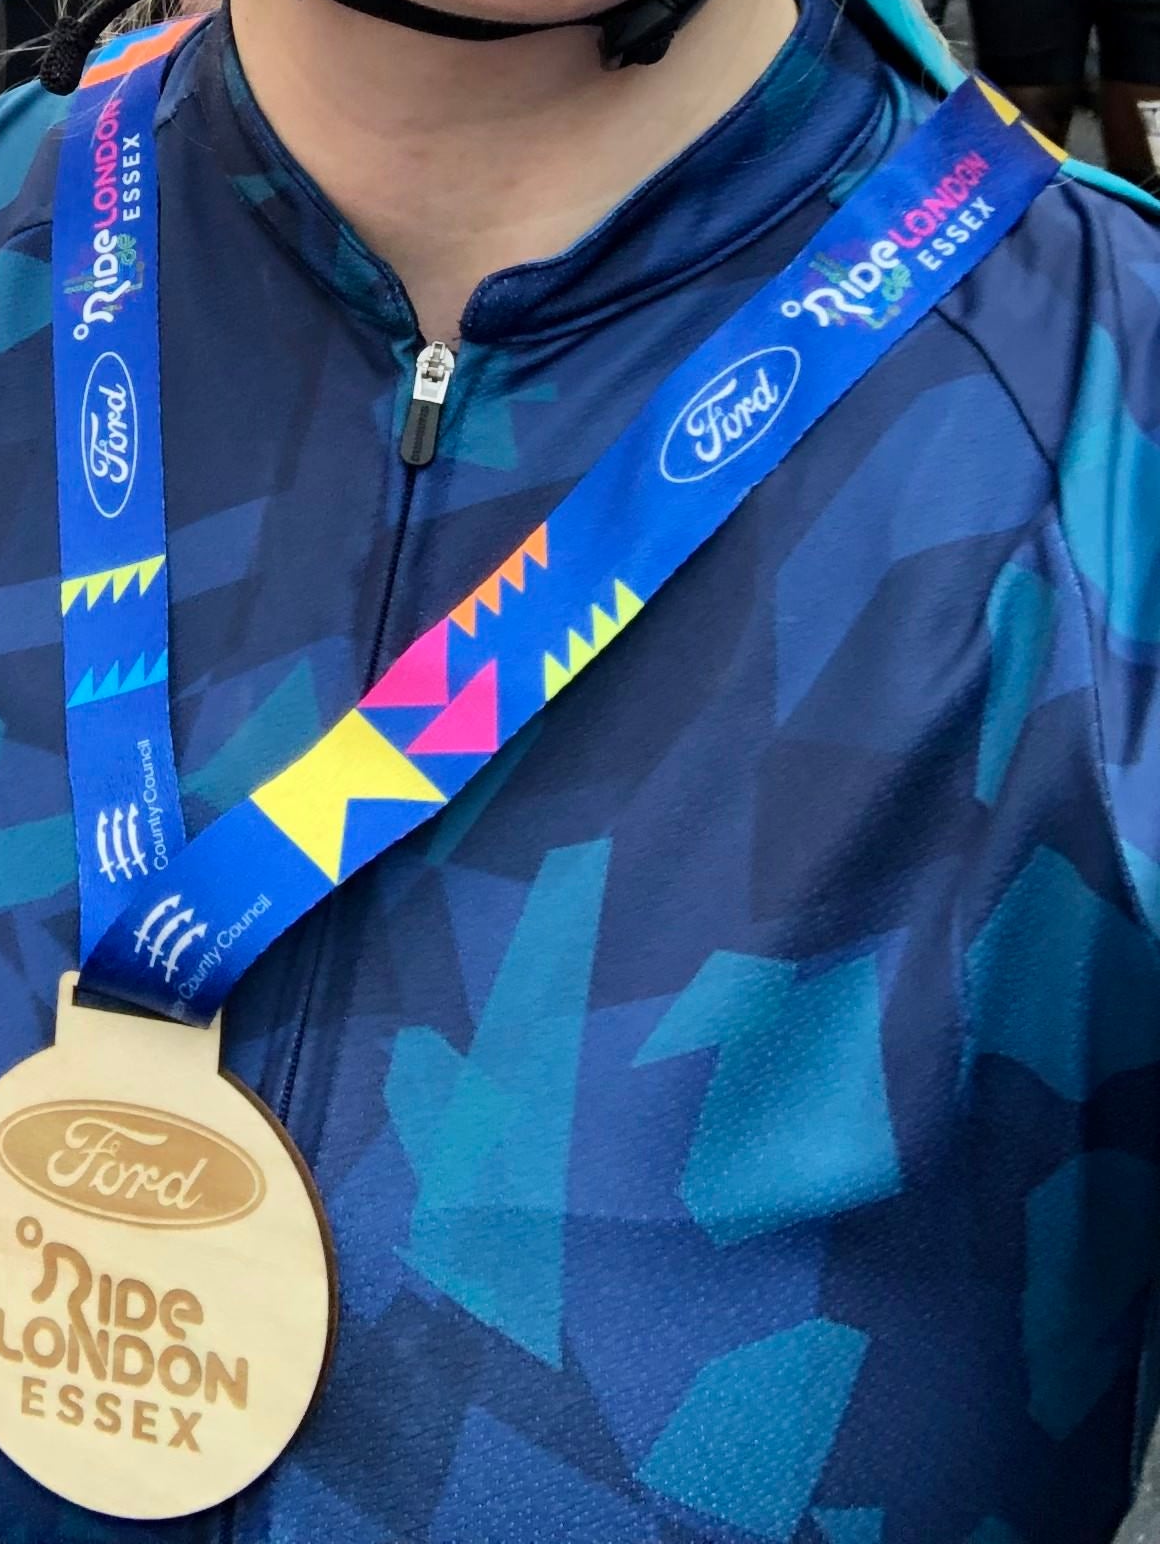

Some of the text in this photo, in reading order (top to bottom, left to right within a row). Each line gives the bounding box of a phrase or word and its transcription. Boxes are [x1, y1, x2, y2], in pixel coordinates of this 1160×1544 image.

[122, 132, 141, 222] ESSEX
[916, 195, 996, 272] ESSEX
[89, 382, 129, 484] Ford
[686, 367, 779, 463] Ford
[136, 738, 170, 872] County Council
[177, 893, 273, 1000] County Council
[46, 1116, 209, 1211] Ford
[20, 1375, 203, 1454] ESSEX
